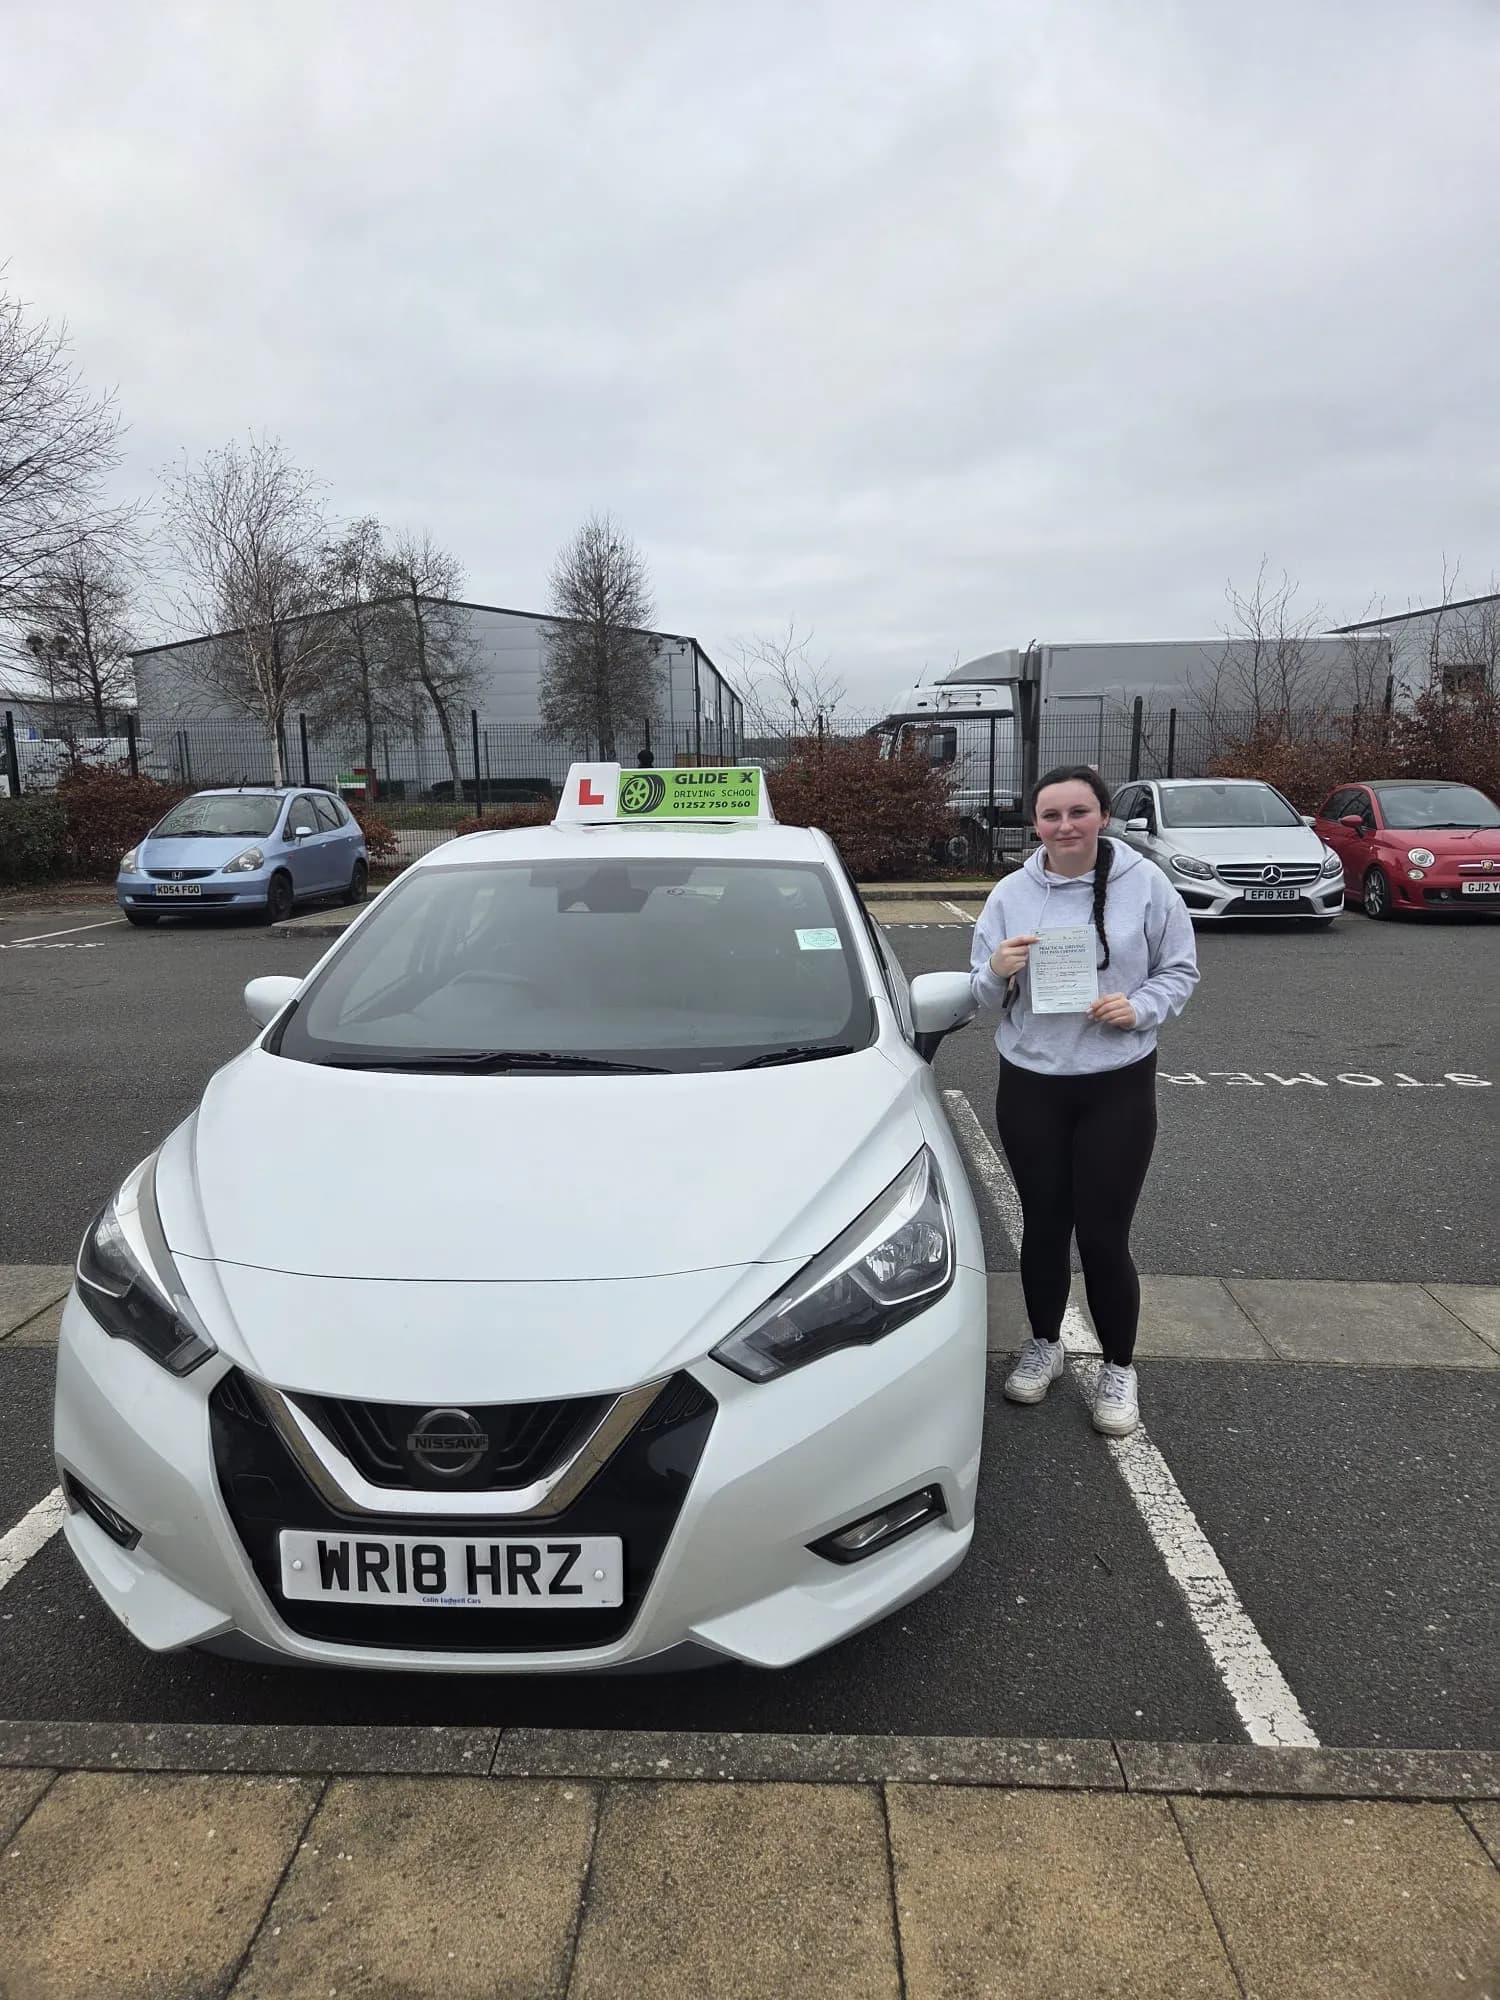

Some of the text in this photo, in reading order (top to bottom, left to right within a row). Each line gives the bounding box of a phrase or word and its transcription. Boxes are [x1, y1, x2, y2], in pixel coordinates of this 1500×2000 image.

[675, 772, 753, 785] GLIDE X
[578, 779, 605, 806] L
[674, 788, 756, 798] DRIVING SCHOOL
[708, 801, 728, 809] 750
[730, 800, 751, 808] 560
[157, 885, 180, 894] KD54
[1468, 883, 1490, 892] GJ12
[1251, 890, 1295, 899] EF18 XEB
[415, 1437, 481, 1449] NISSAN
[316, 1539, 583, 1596] WR18 HRZ
